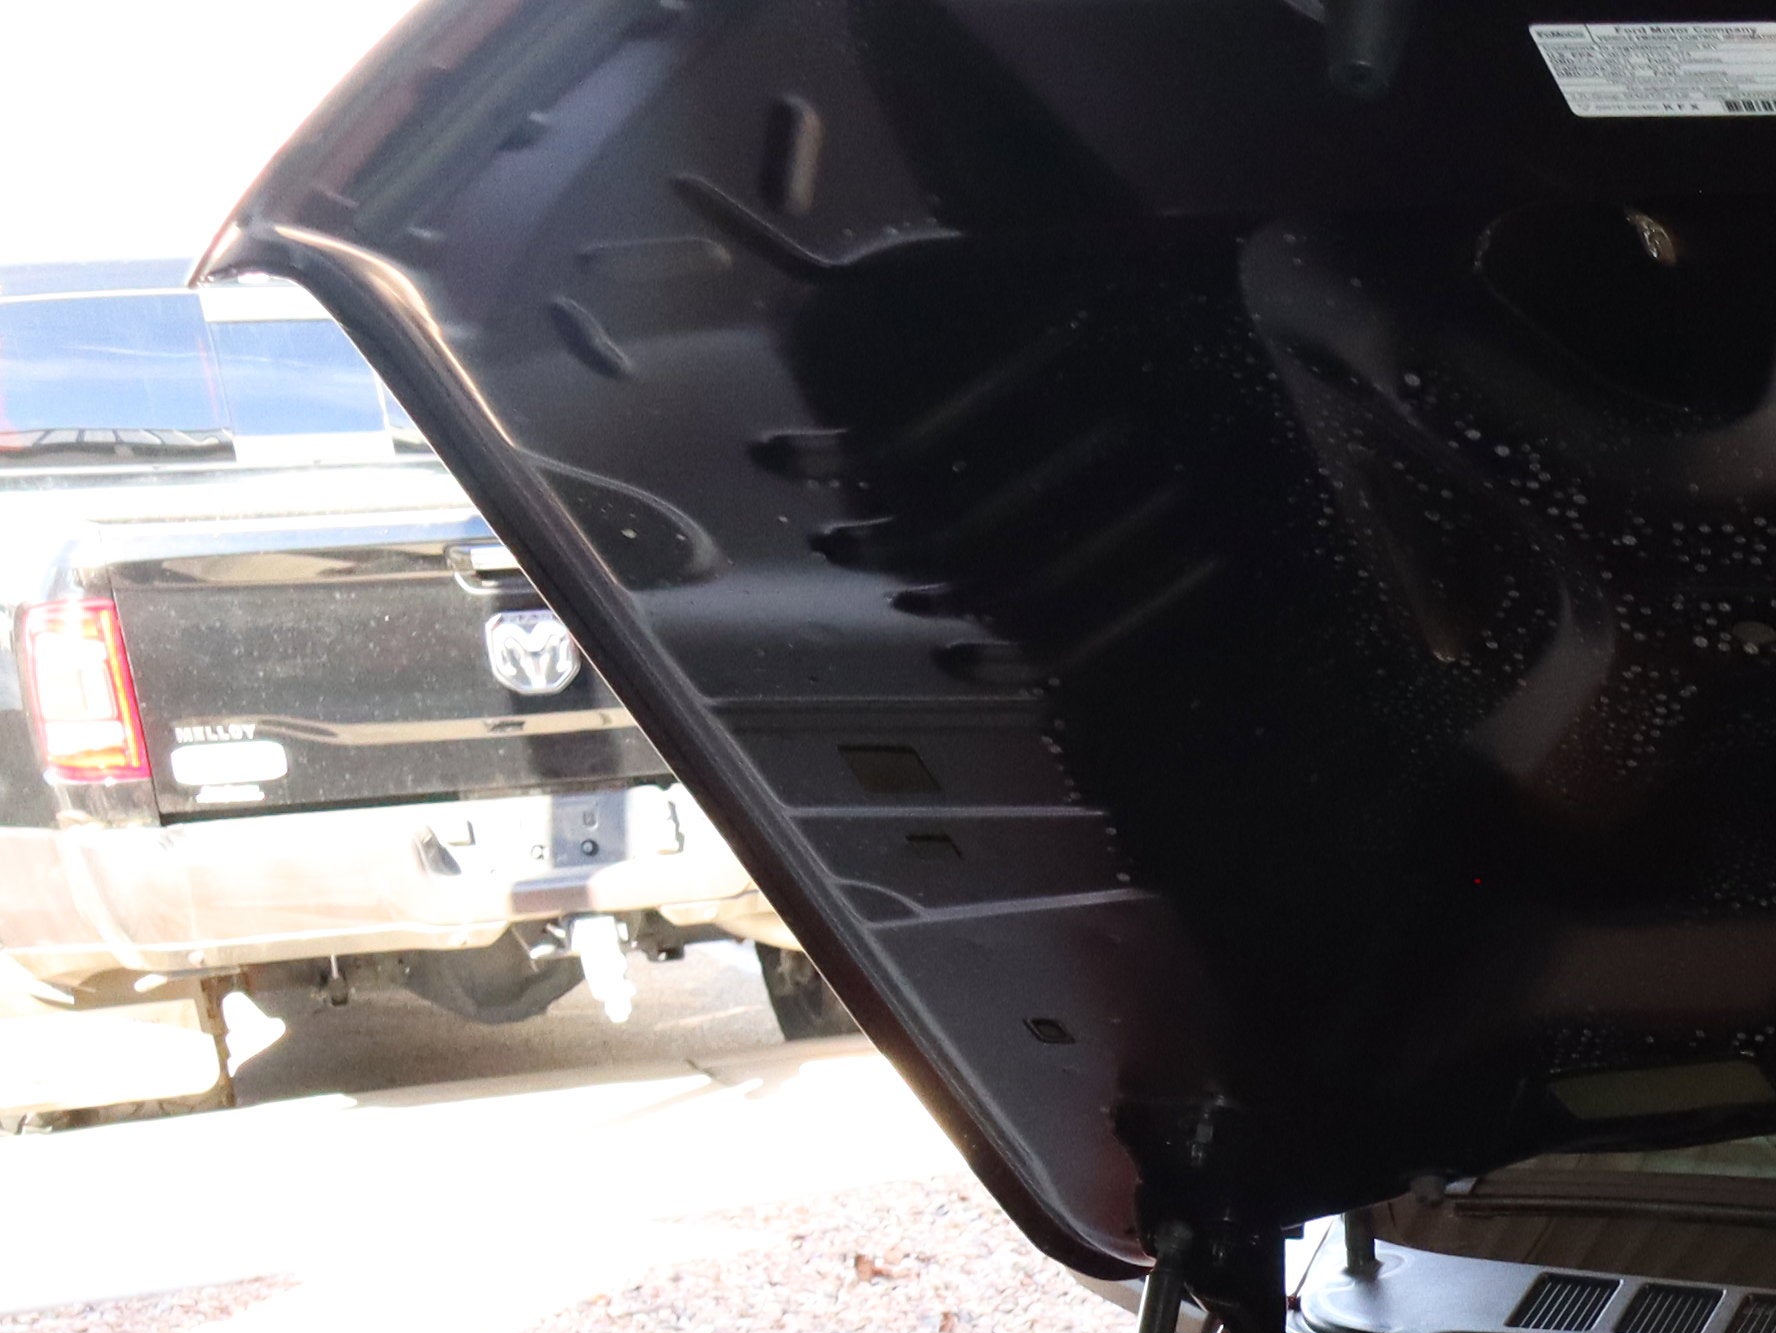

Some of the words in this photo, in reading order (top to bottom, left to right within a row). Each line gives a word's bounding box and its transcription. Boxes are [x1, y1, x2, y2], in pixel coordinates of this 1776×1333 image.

[1613, 25, 1646, 34] Ford
[1650, 25, 1689, 34] Motor
[1692, 25, 1757, 37] Company
[174, 723, 257, 744] MELLOY
